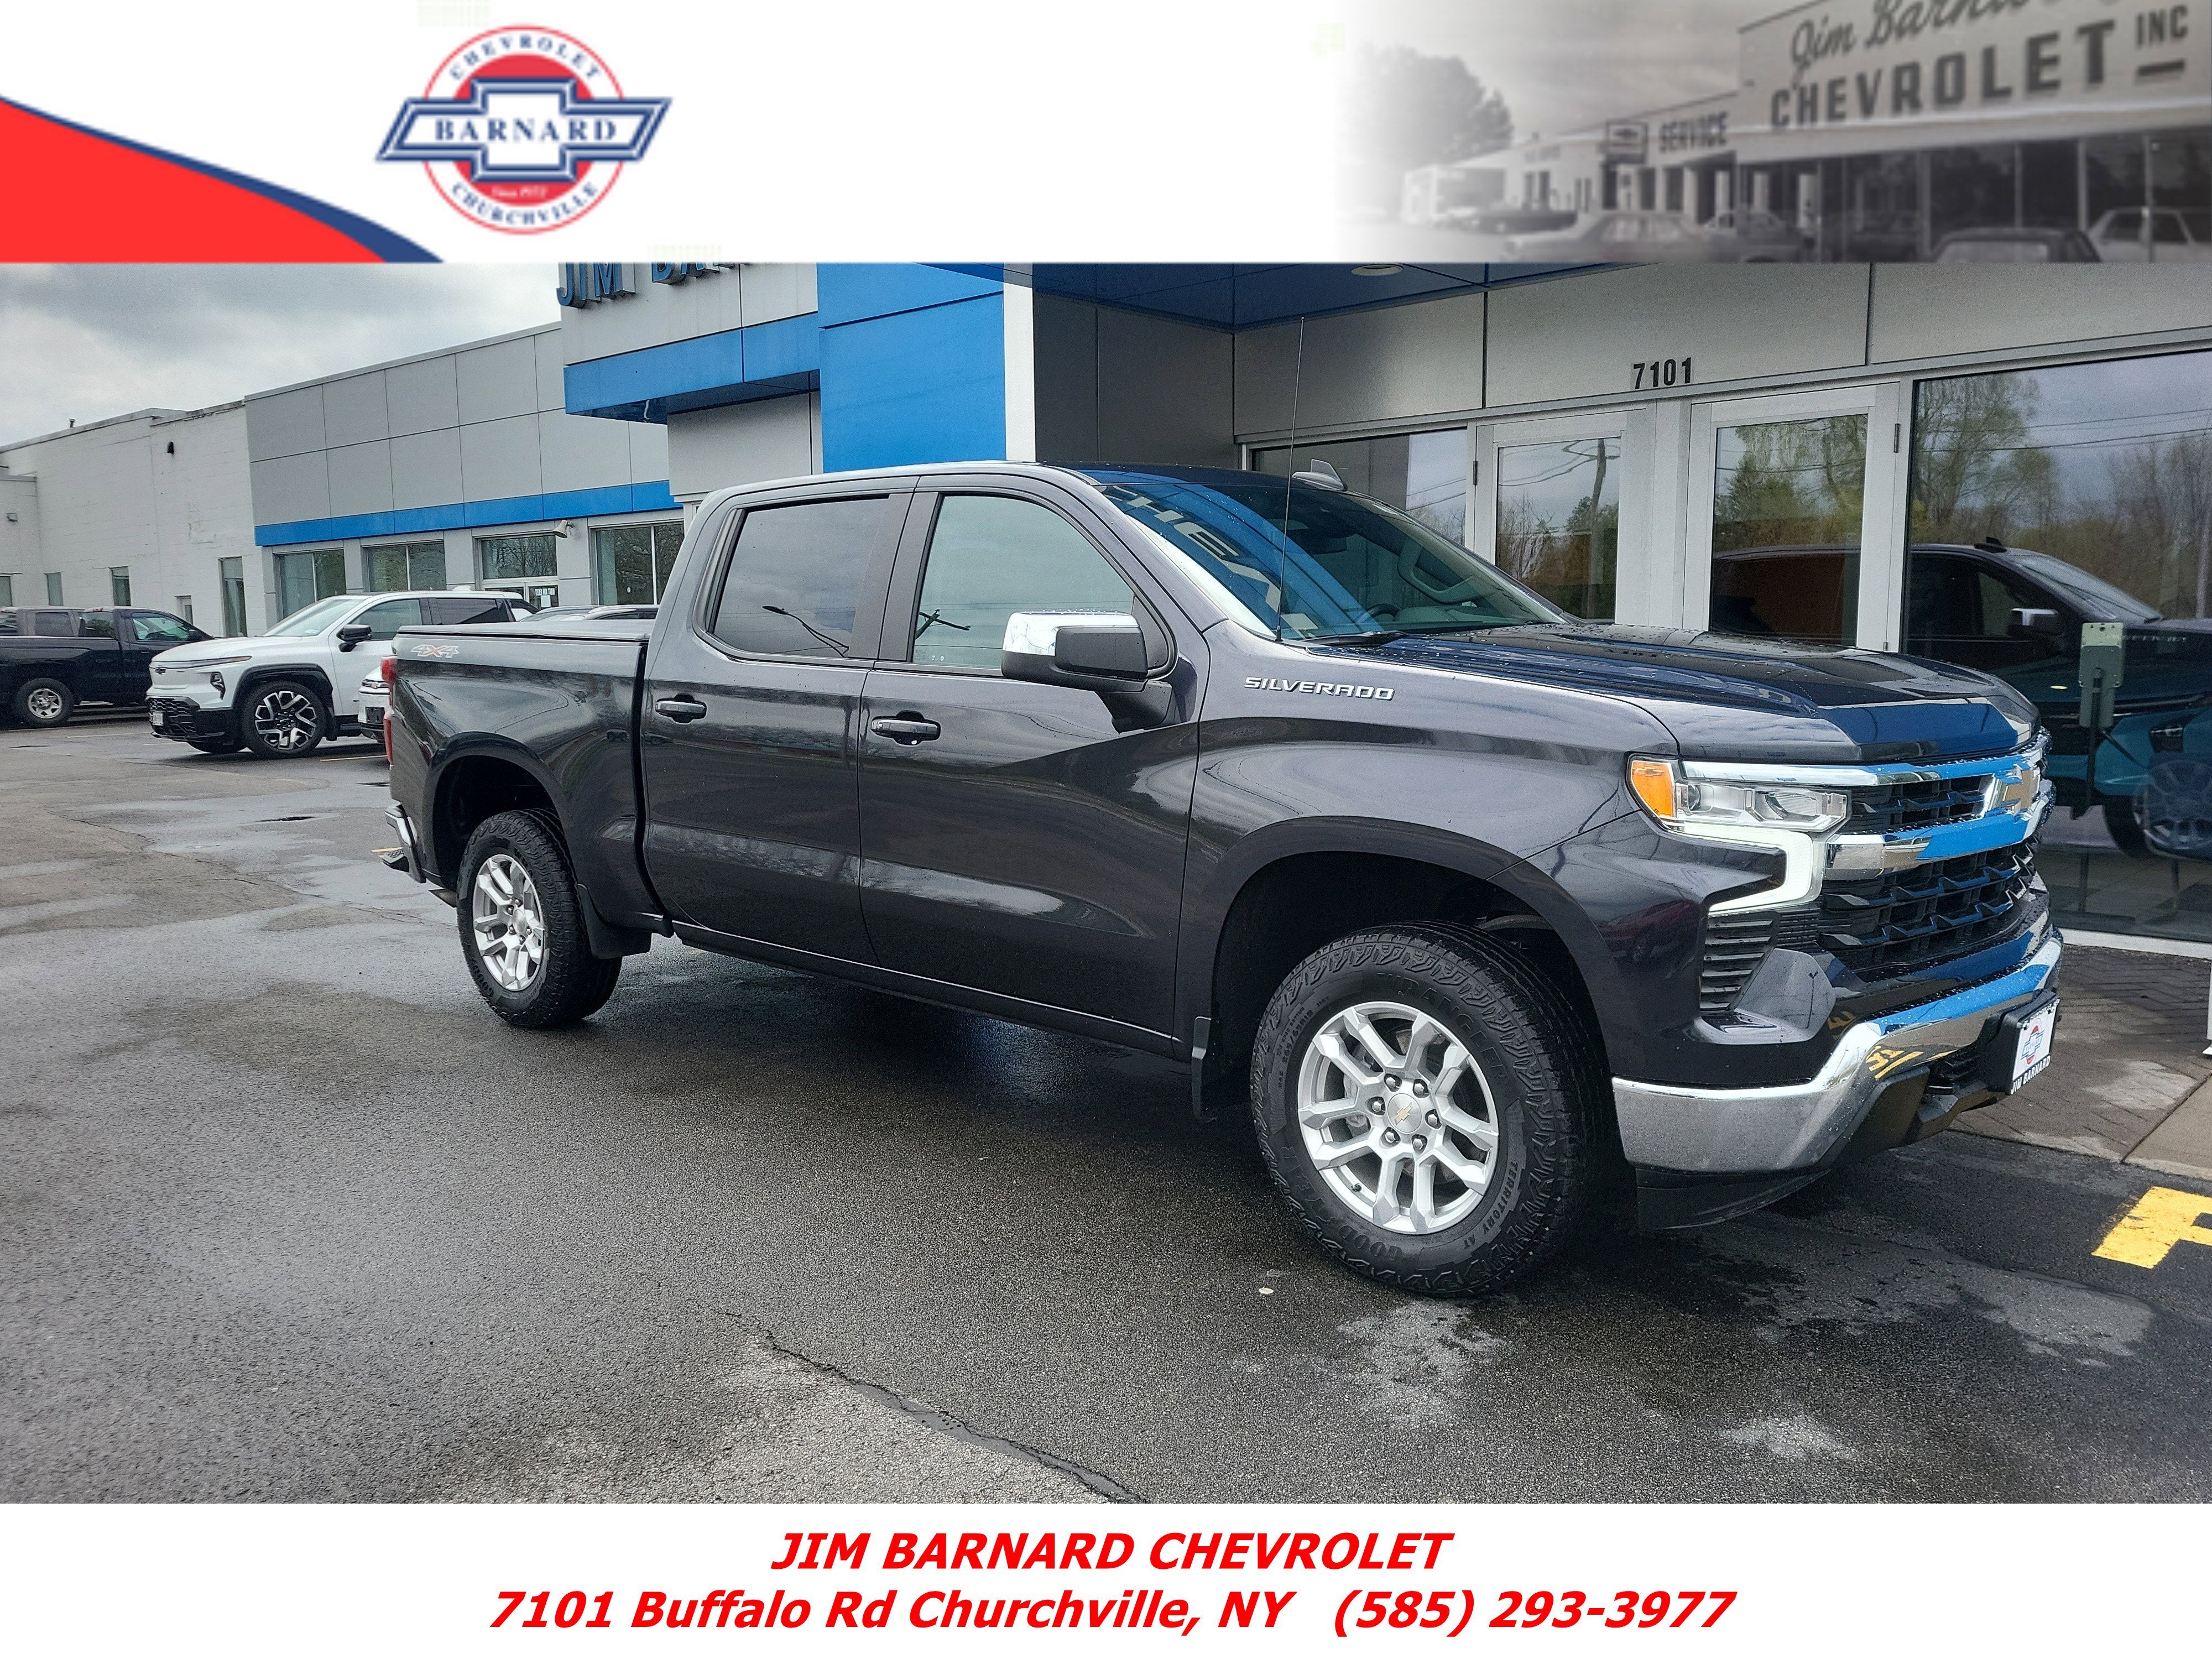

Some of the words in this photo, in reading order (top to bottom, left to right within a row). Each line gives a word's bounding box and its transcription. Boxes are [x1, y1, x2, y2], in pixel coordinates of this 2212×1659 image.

[1633, 357, 1691, 389] 7101
[1244, 676, 1395, 701] SILVERADO
[2010, 1076, 2023, 1095] JIM
[2022, 1055, 2051, 1085] BARNARD
[1482, 1160, 1519, 1235] TERRITORY
